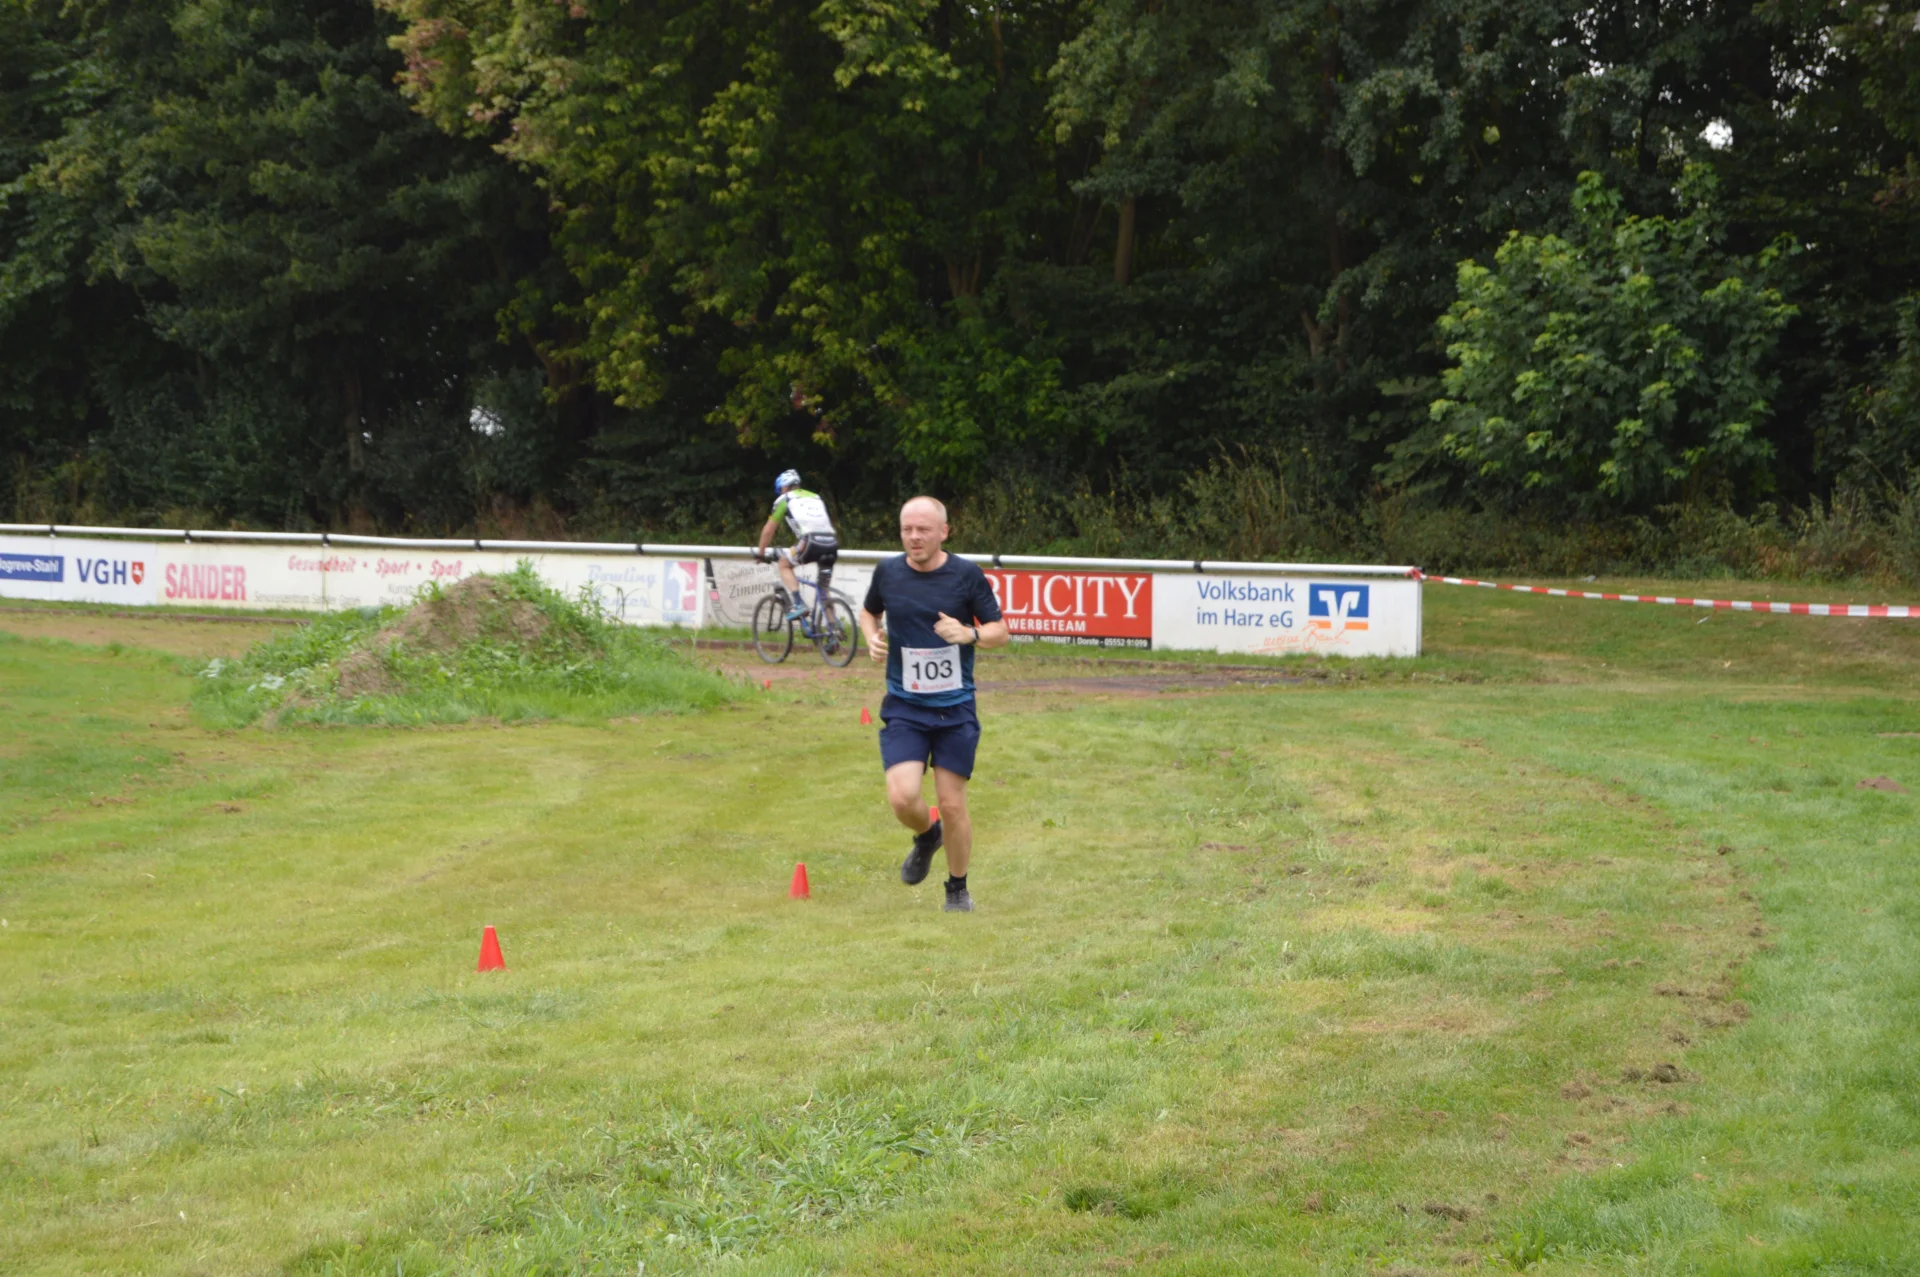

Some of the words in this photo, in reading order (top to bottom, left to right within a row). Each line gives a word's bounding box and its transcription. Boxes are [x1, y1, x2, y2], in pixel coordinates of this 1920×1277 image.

[76, 558, 127, 585] VGH
[288, 554, 357, 572] Gesundheit
[375, 557, 410, 578] Sport
[430, 559, 462, 579] Spaß
[587, 564, 656, 588] Bowling
[165, 562, 247, 601] SANDER
[1197, 580, 1295, 603] Volksbank
[1008, 618, 1086, 633] WERBETEAM
[1197, 606, 1218, 625] im
[1224, 608, 1263, 627] Harz
[1269, 610, 1293, 628] eG
[911, 659, 953, 681] 103
